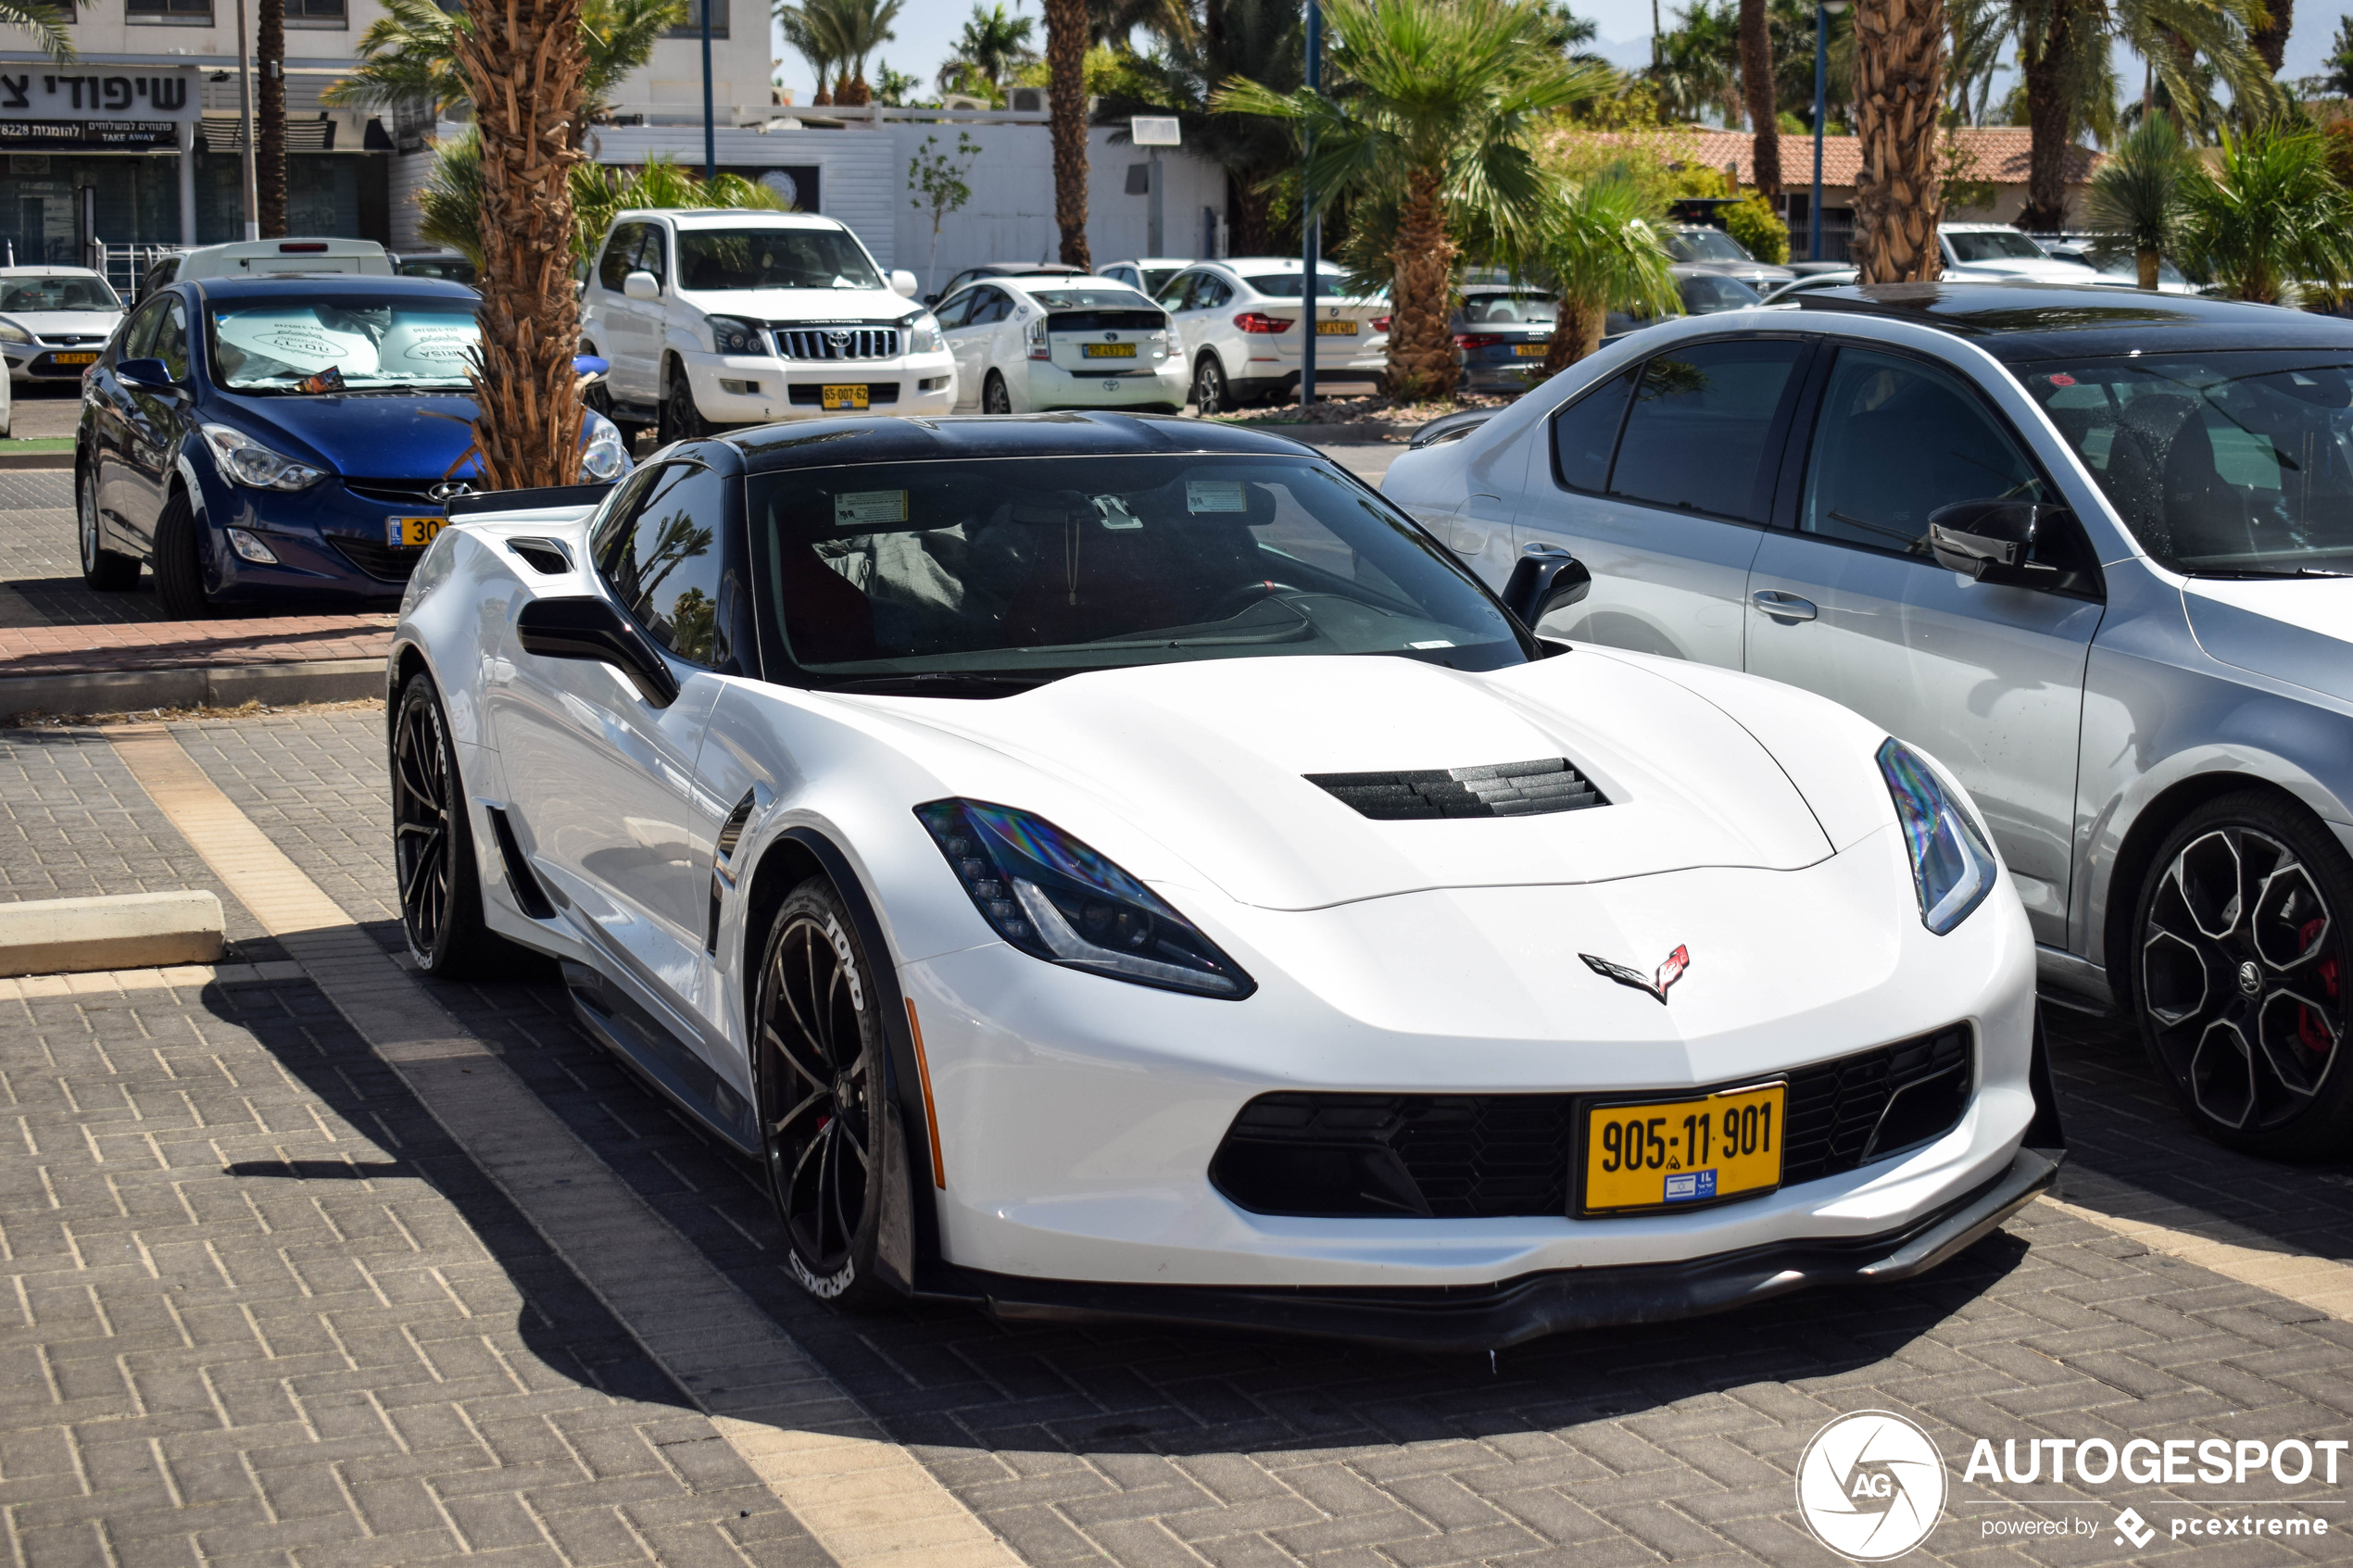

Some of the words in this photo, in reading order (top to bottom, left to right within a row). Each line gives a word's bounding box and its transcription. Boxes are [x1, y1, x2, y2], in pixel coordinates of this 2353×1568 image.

[44, 75, 186, 111] שיפודי
[0, 124, 30, 136] 8228
[138, 122, 172, 132] פתוחים
[102, 133, 126, 143] TAKE
[129, 132, 156, 142] AWAY
[824, 387, 868, 401] 65-007-62
[826, 911, 864, 1011] TOYO
[1701, 1172, 1712, 1183] IL
